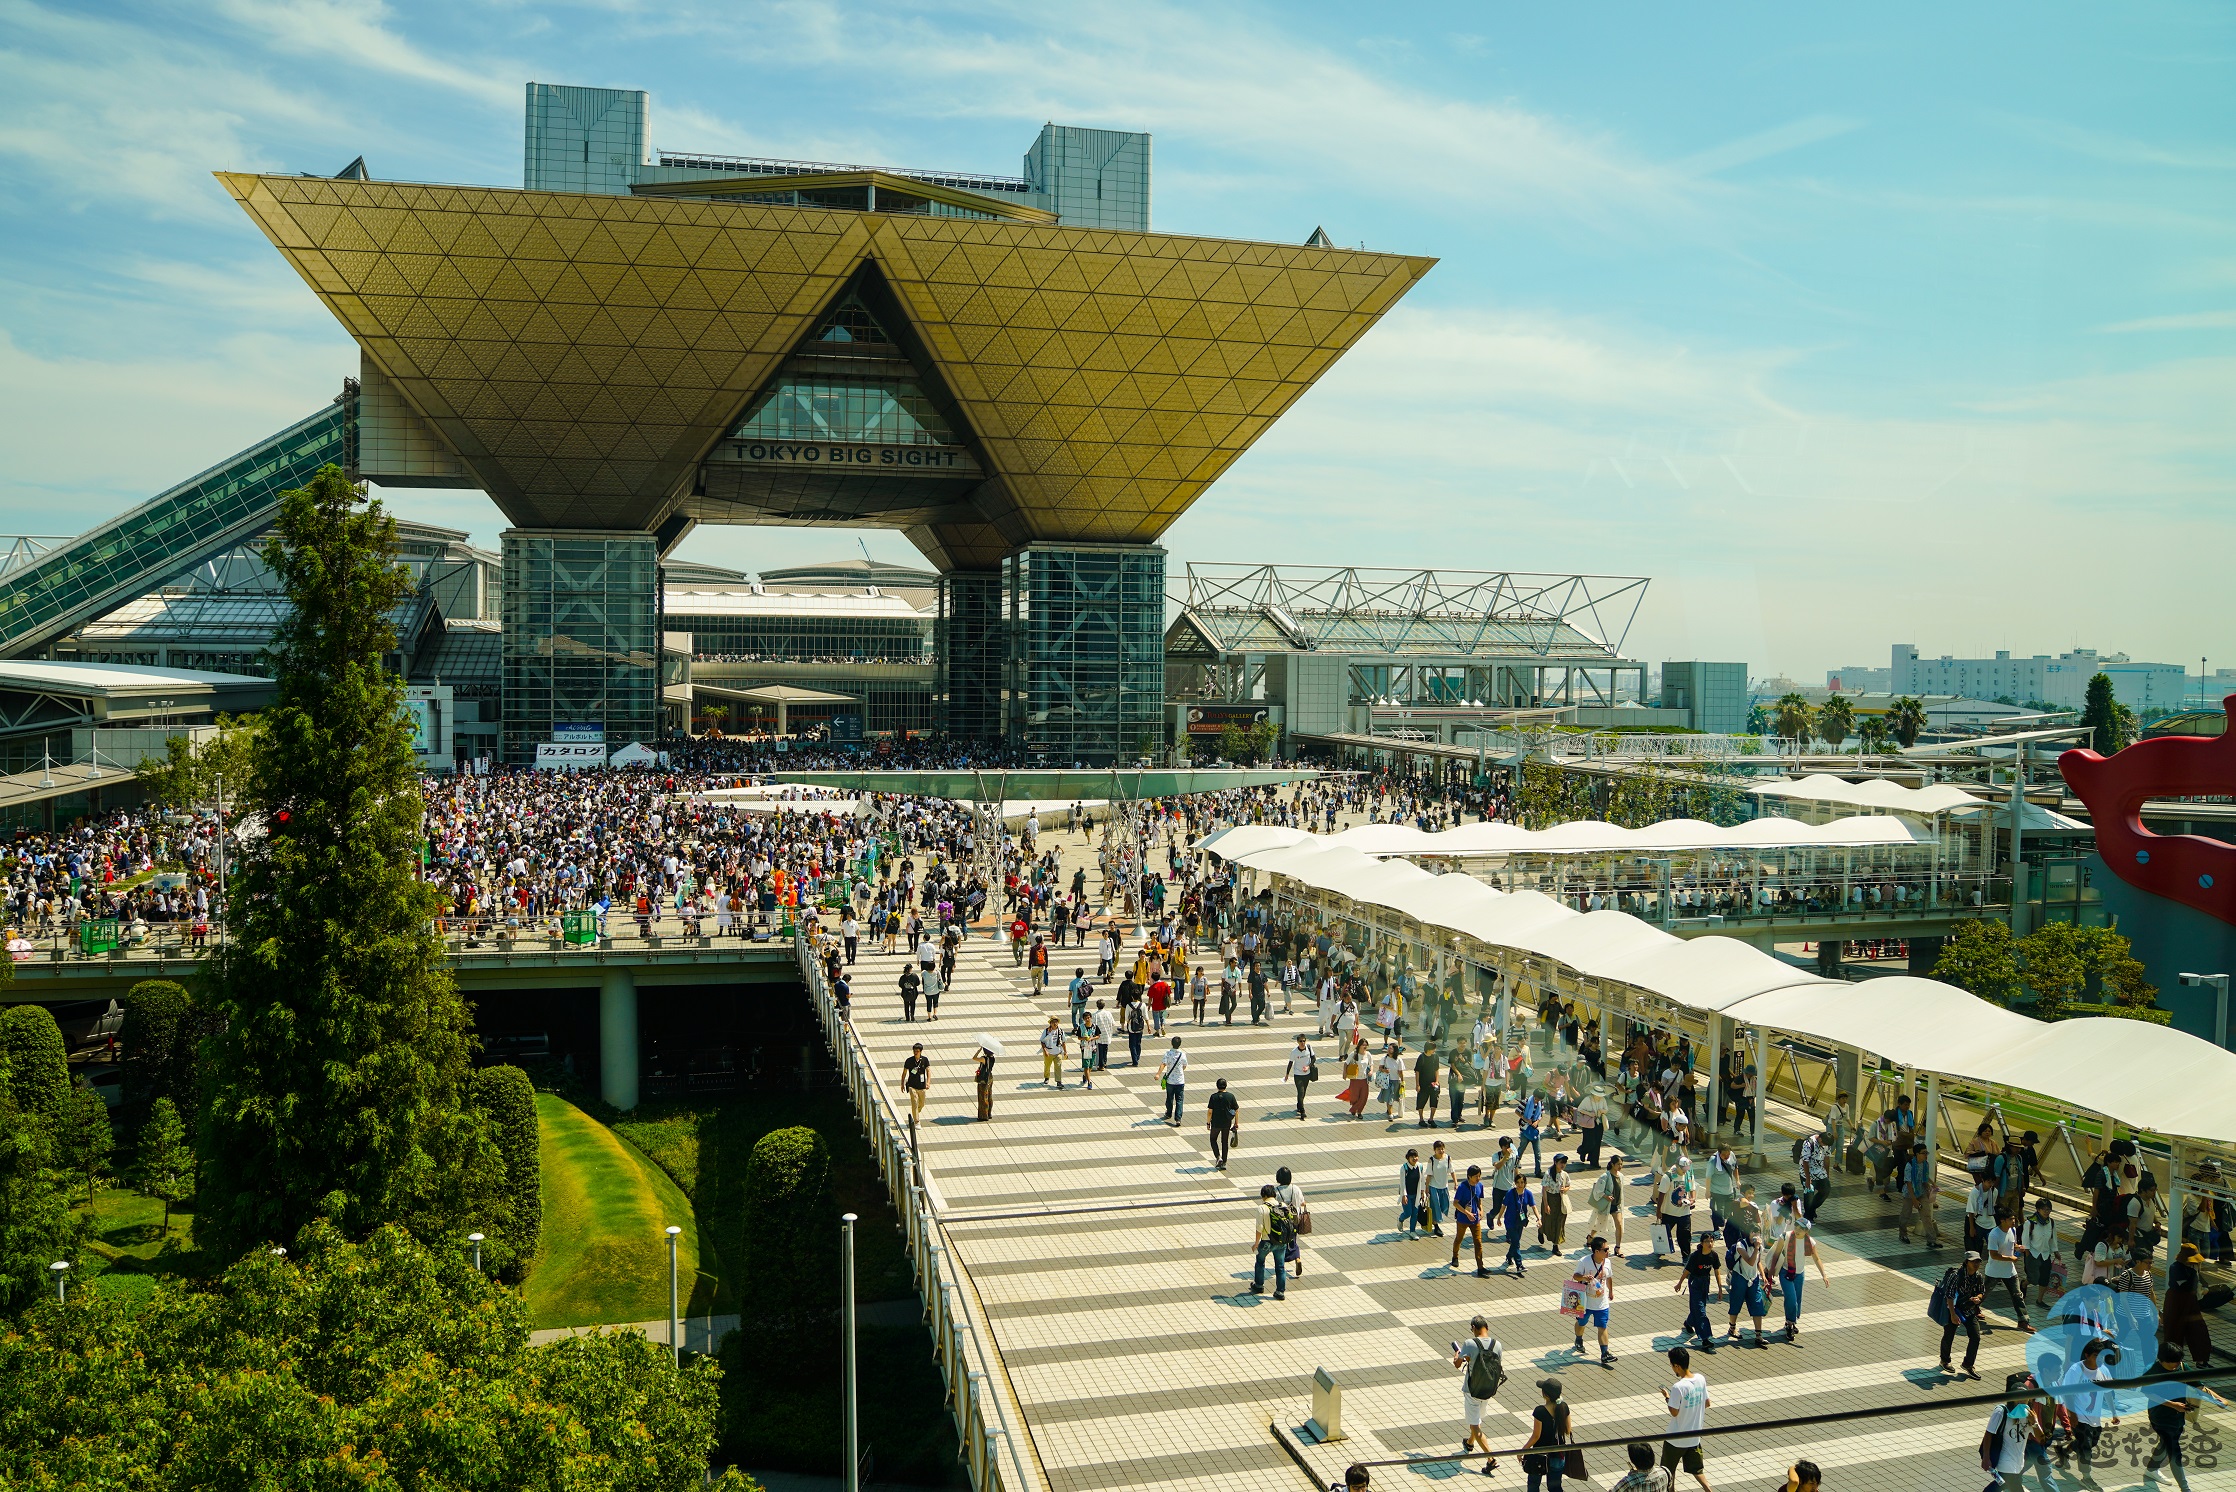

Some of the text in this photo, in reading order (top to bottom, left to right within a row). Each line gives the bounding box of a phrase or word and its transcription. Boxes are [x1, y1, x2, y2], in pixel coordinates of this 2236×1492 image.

[732, 444, 958, 466] TOKYO BIG SIGHT
[543, 746, 602, 756] カタログ
